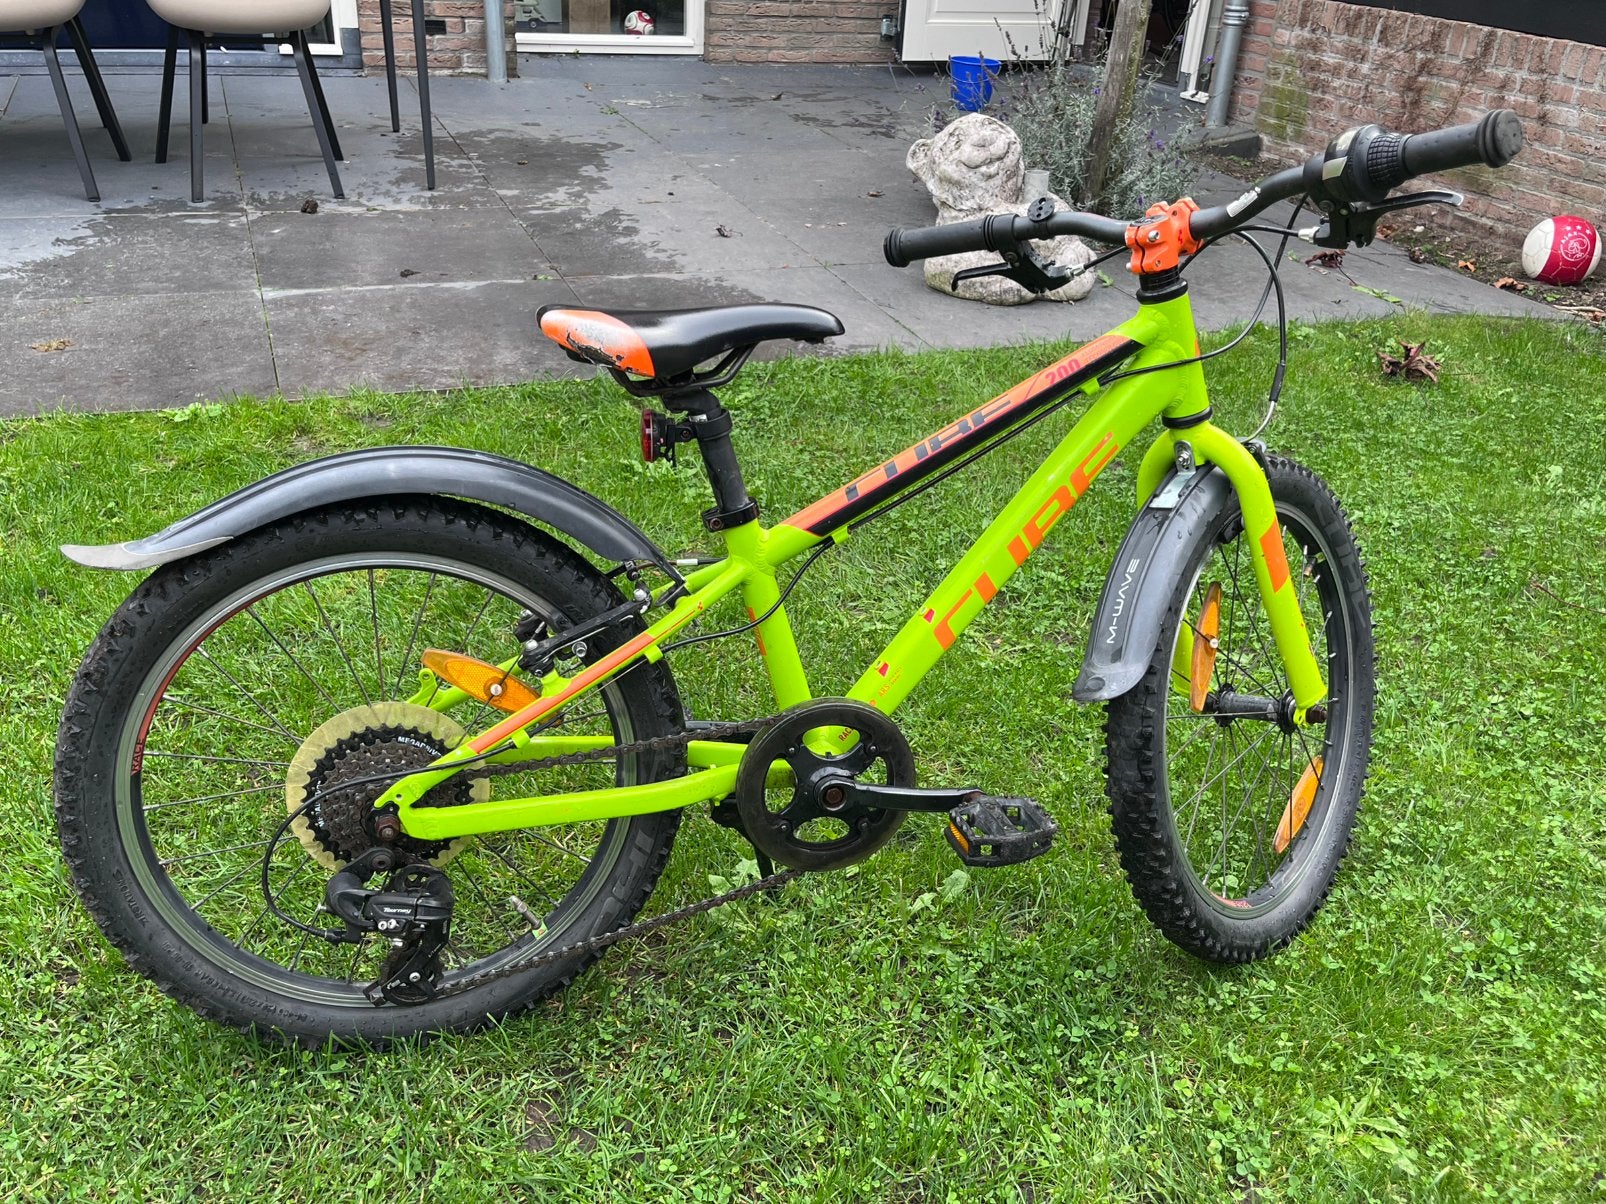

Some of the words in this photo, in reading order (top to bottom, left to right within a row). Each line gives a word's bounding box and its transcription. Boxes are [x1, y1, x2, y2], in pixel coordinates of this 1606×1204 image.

[1045, 358, 1081, 385] 200
[1106, 558, 1140, 643] M-WAVE
[838, 727, 852, 741] RAC
